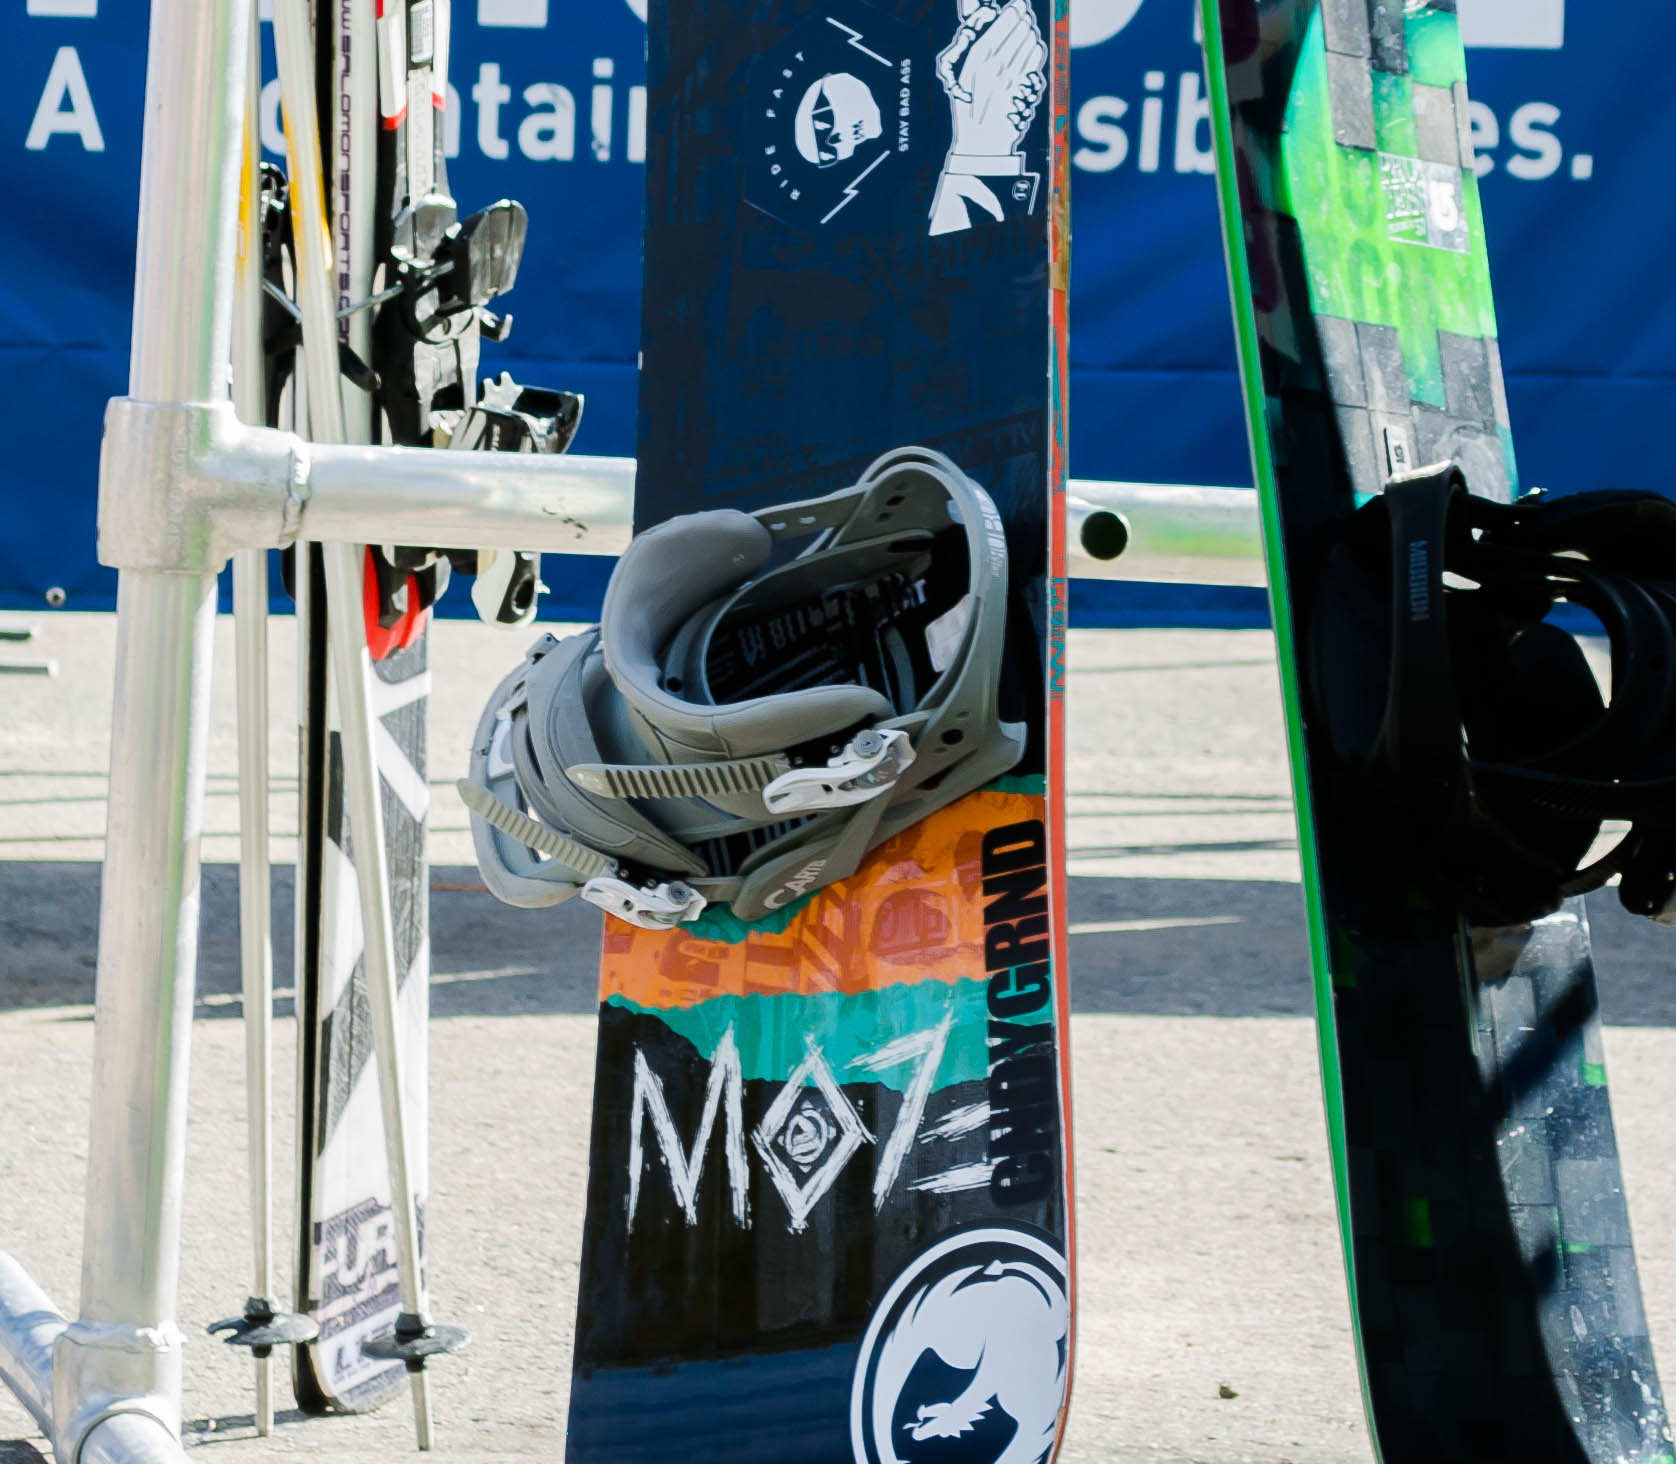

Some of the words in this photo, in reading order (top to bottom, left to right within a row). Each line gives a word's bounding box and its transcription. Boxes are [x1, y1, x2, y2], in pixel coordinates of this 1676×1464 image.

[764, 50, 806, 119] FAST
[899, 58, 912, 84] ASS
[25, 46, 106, 152] A
[898, 87, 911, 117] BAD
[898, 120, 911, 153] STAY
[764, 144, 801, 201] RIDE
